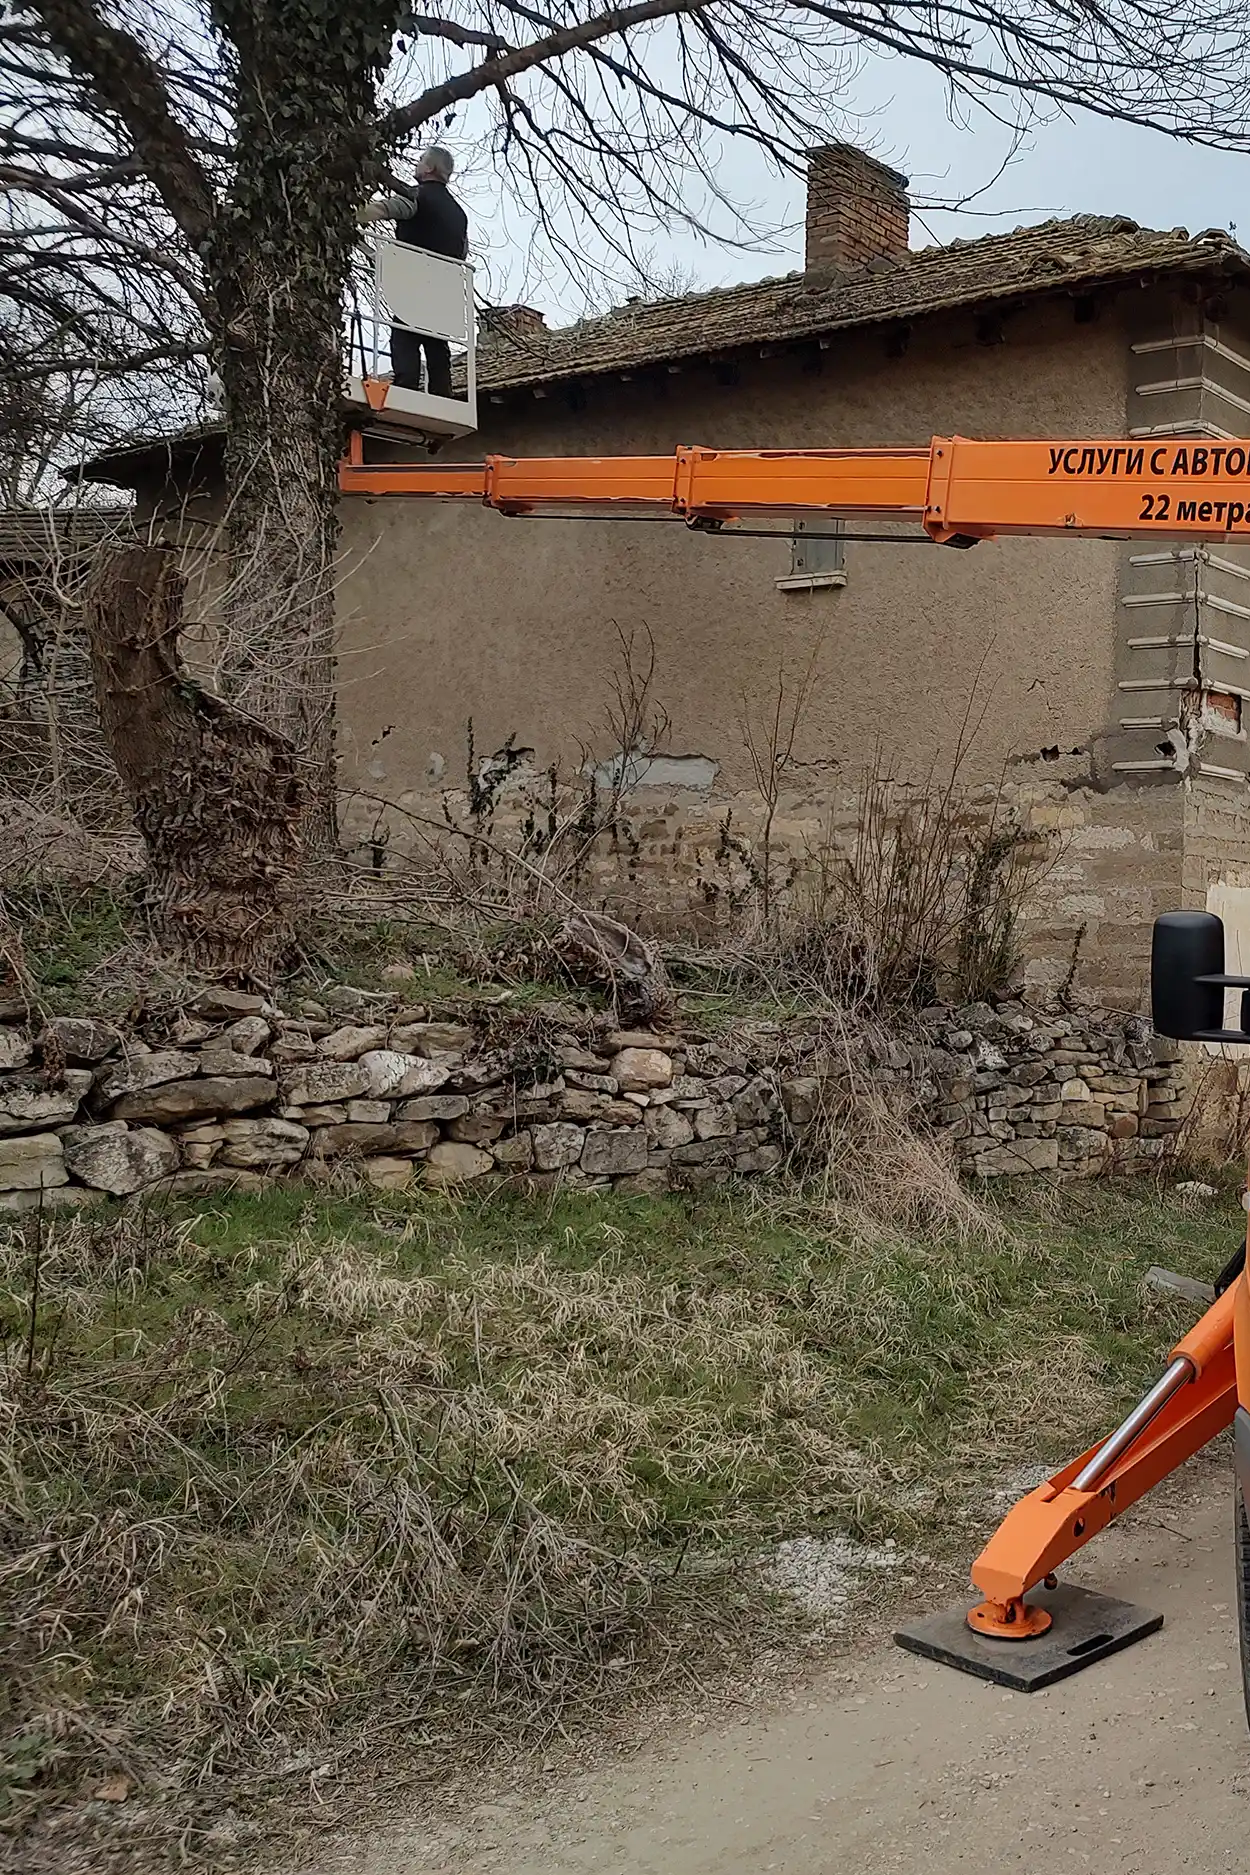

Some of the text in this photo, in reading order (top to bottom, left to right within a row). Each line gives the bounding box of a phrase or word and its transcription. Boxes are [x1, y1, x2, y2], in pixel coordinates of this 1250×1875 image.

[1048, 447, 1145, 475] УСЛУГИ
[1150, 447, 1168, 475] С
[1138, 493, 1171, 521] 22
